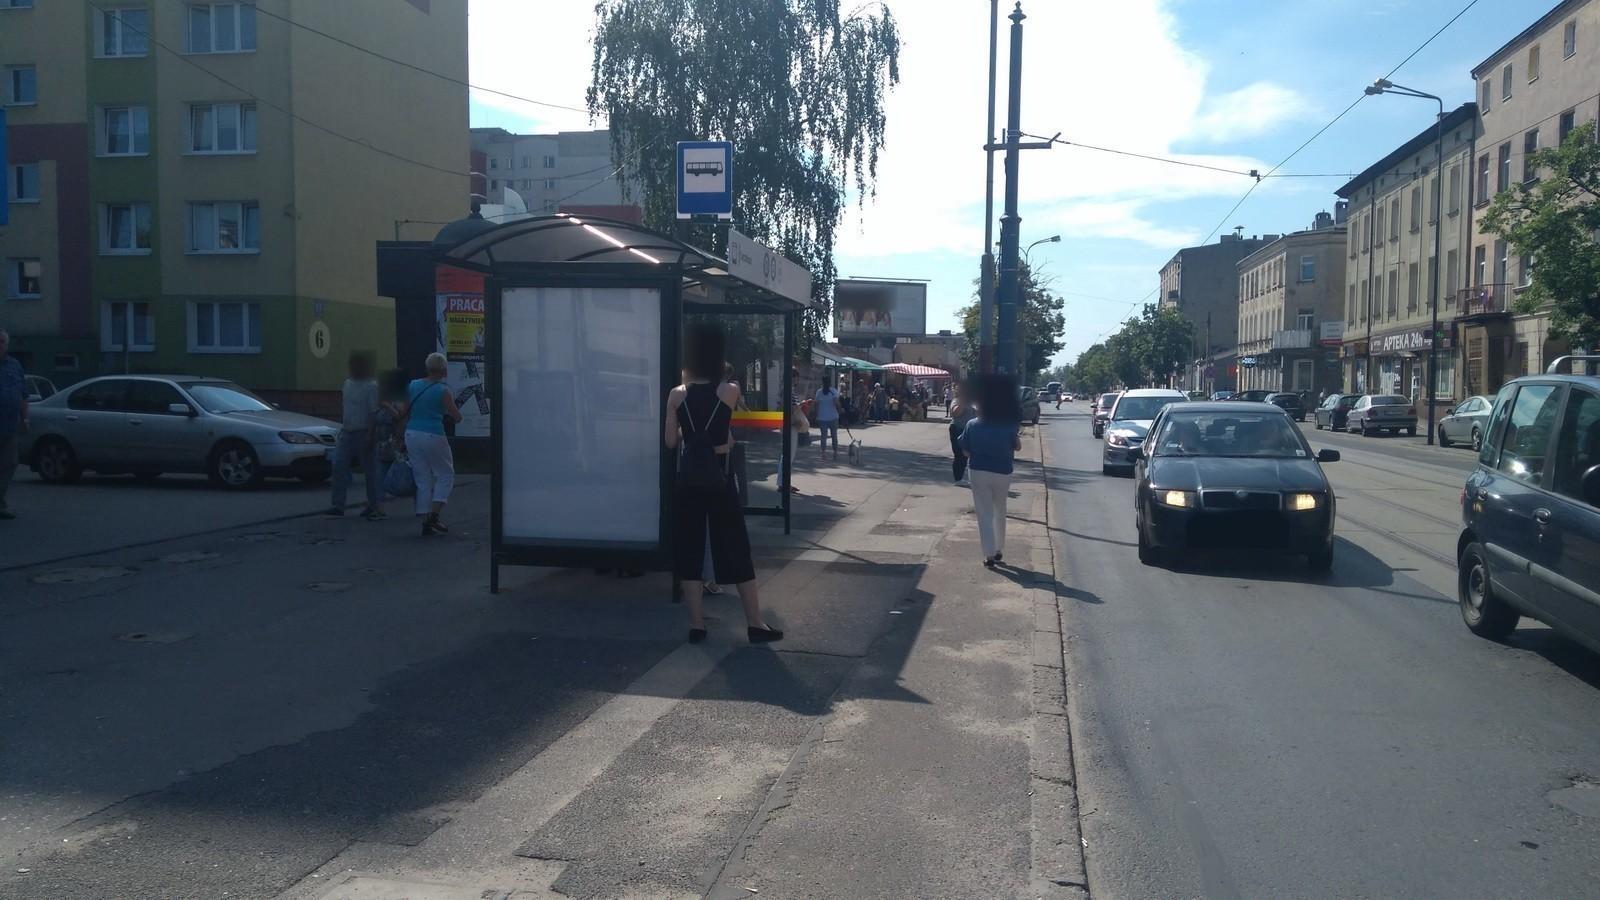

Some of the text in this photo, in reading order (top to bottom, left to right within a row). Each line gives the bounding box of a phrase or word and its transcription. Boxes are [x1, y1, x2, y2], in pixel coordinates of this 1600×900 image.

[450, 299, 484, 311] PRACA
[315, 329, 324, 349] 6
[1384, 334, 1410, 351] APTEKA
[1411, 332, 1423, 348] 24h
